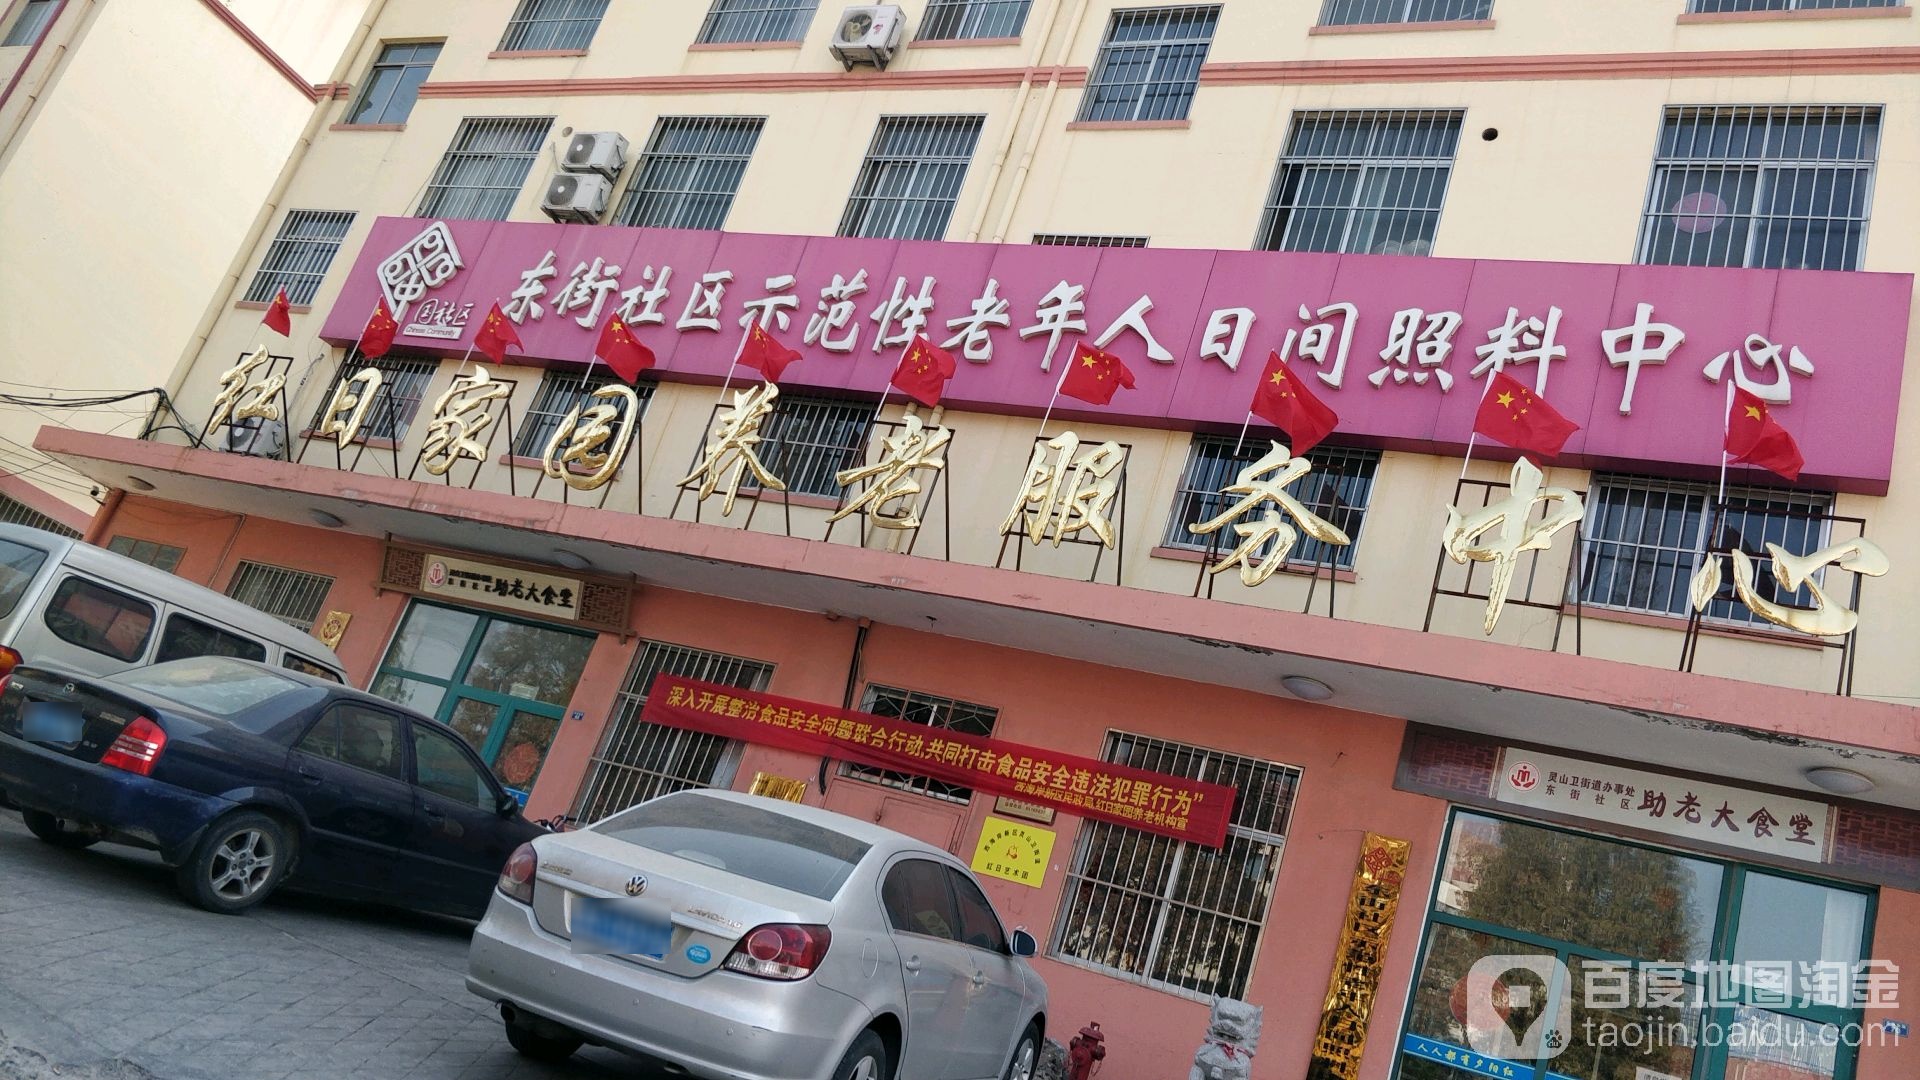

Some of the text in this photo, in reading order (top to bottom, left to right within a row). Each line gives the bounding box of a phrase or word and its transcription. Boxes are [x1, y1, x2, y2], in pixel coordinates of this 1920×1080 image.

[428, 328, 456, 337] Community
[501, 250, 1815, 415] 东街社区示范性老年人日间照料中心
[207, 343, 1890, 636] 红日家园养老服务中心
[1545, 784, 1631, 811] 东街社区
[1547, 771, 1636, 797] 灵山卫街道办事处
[1636, 789, 1816, 846] 助老大食堂
